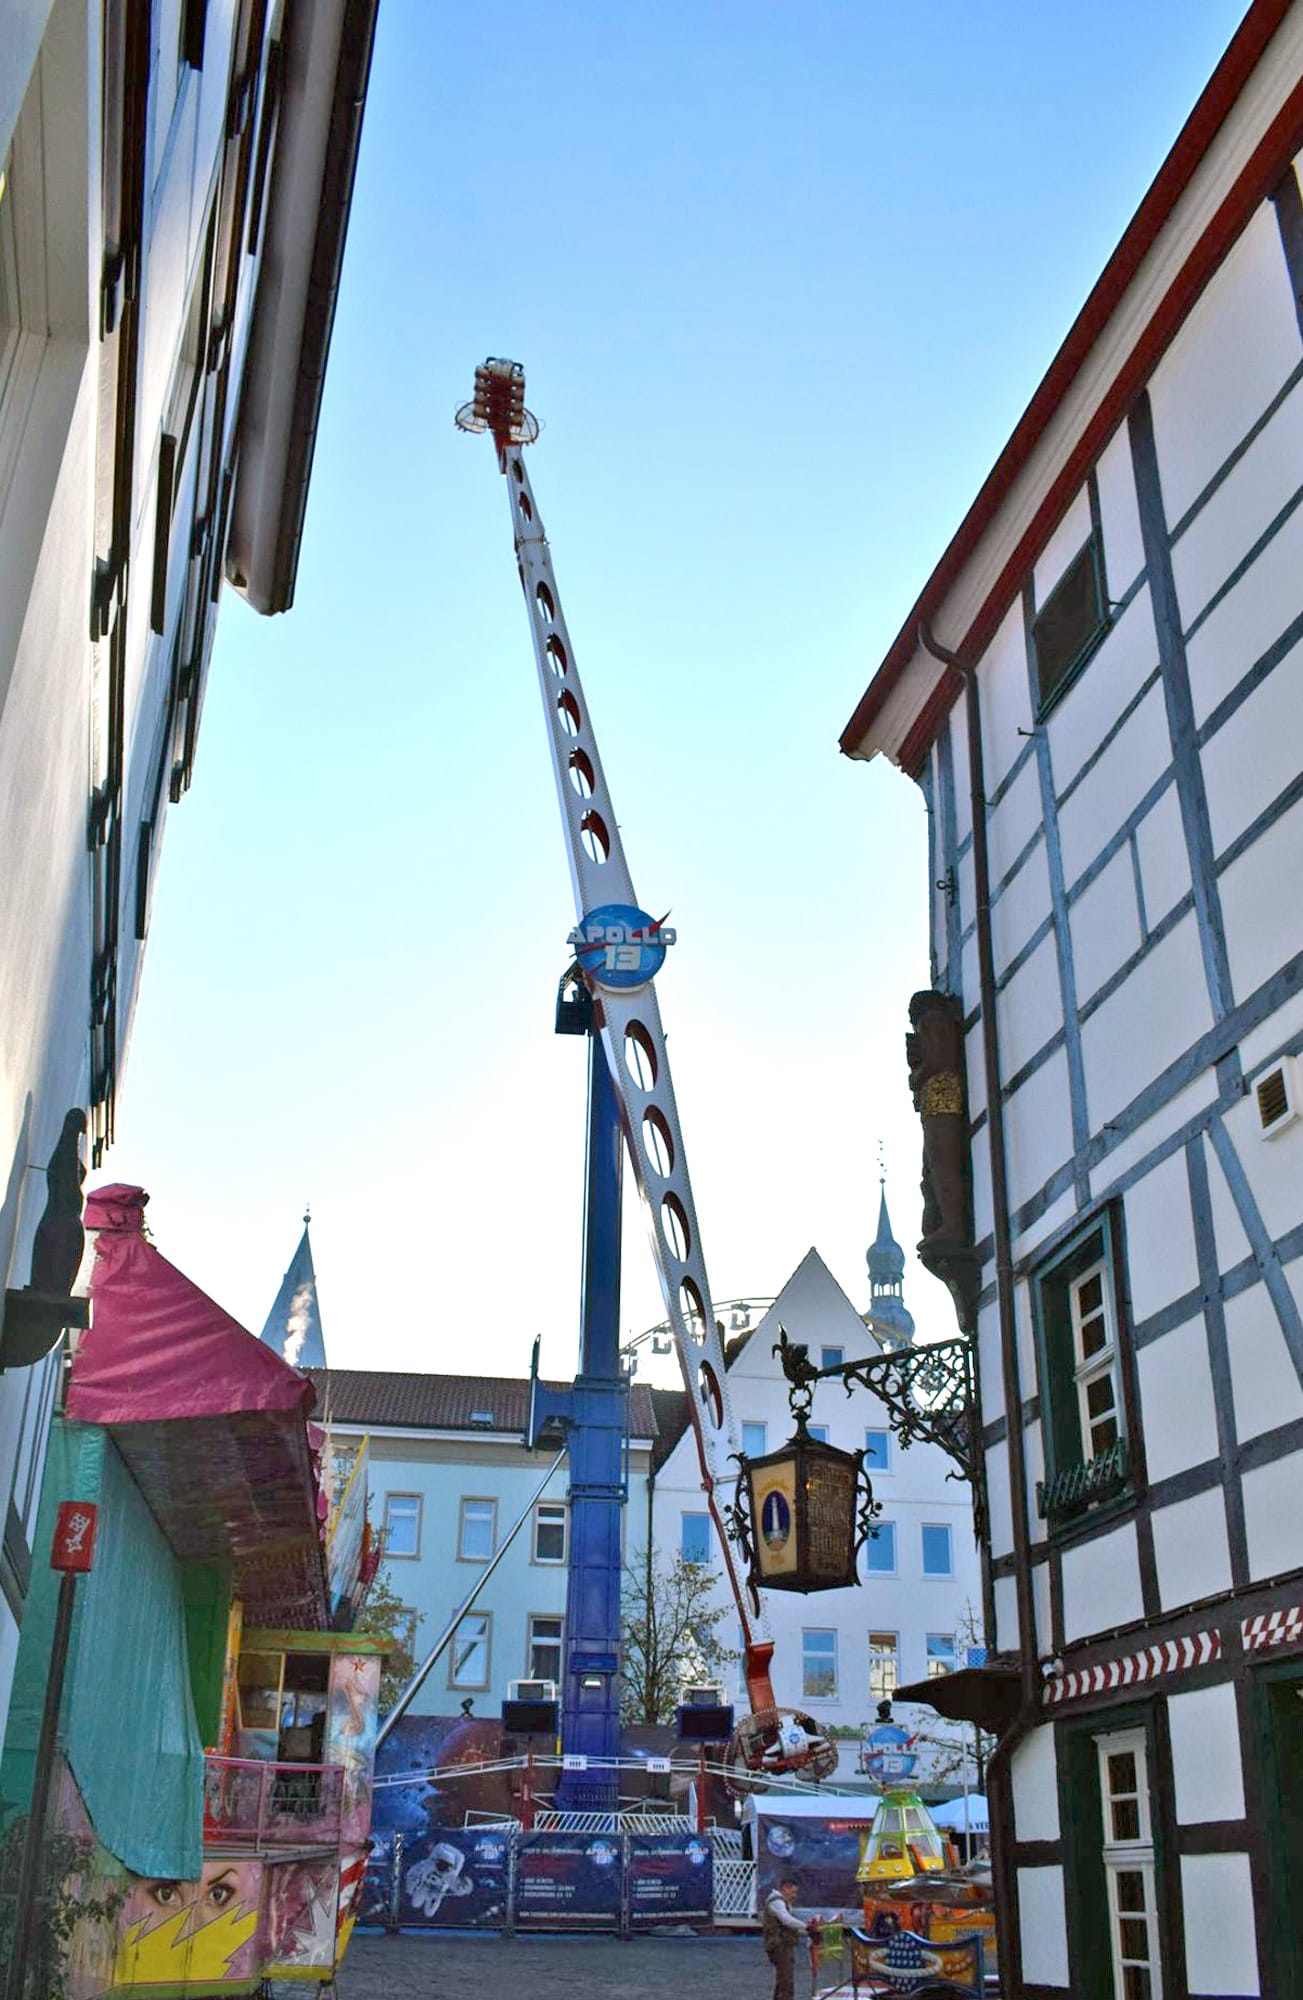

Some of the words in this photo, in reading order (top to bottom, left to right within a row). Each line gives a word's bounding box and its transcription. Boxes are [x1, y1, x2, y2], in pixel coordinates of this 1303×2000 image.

[566, 926, 677, 946] APOLLO
[605, 944, 641, 971] 13
[862, 1742, 920, 1755] APOLLO
